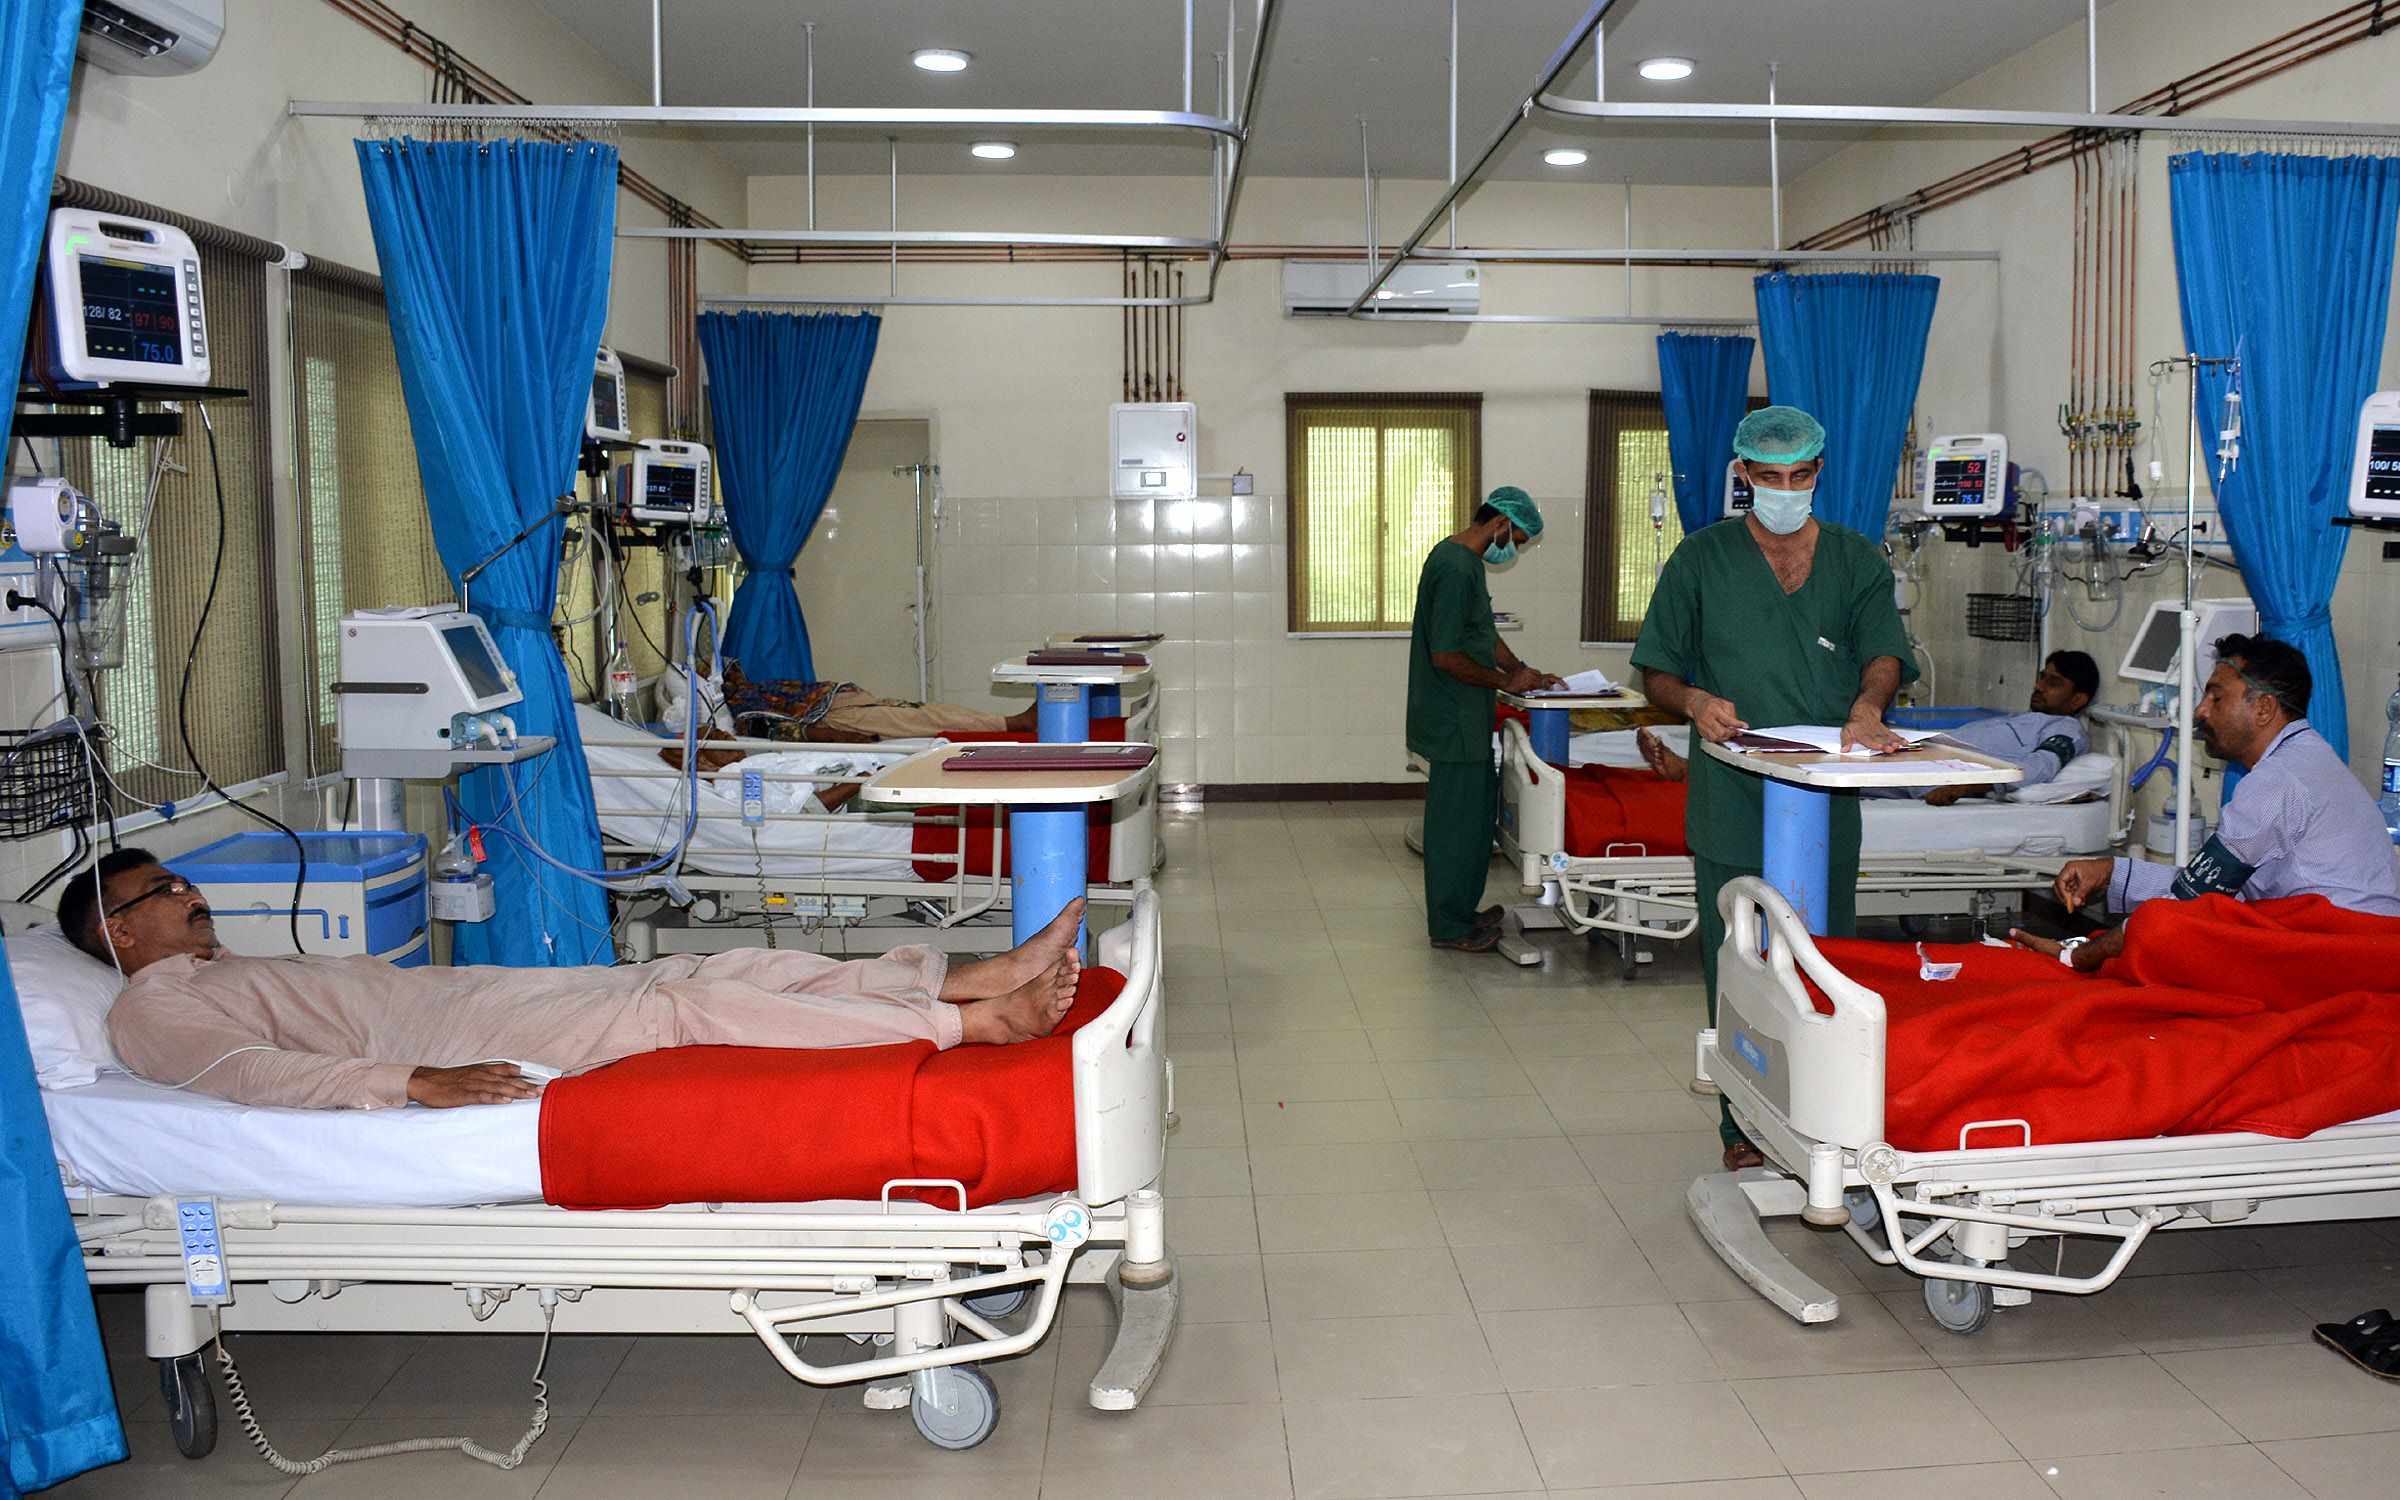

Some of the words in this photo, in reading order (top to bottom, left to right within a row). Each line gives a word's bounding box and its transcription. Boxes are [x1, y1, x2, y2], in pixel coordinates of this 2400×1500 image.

[108, 307, 122, 321] 82
[134, 312, 150, 327] 97
[142, 341, 174, 362] 75.0
